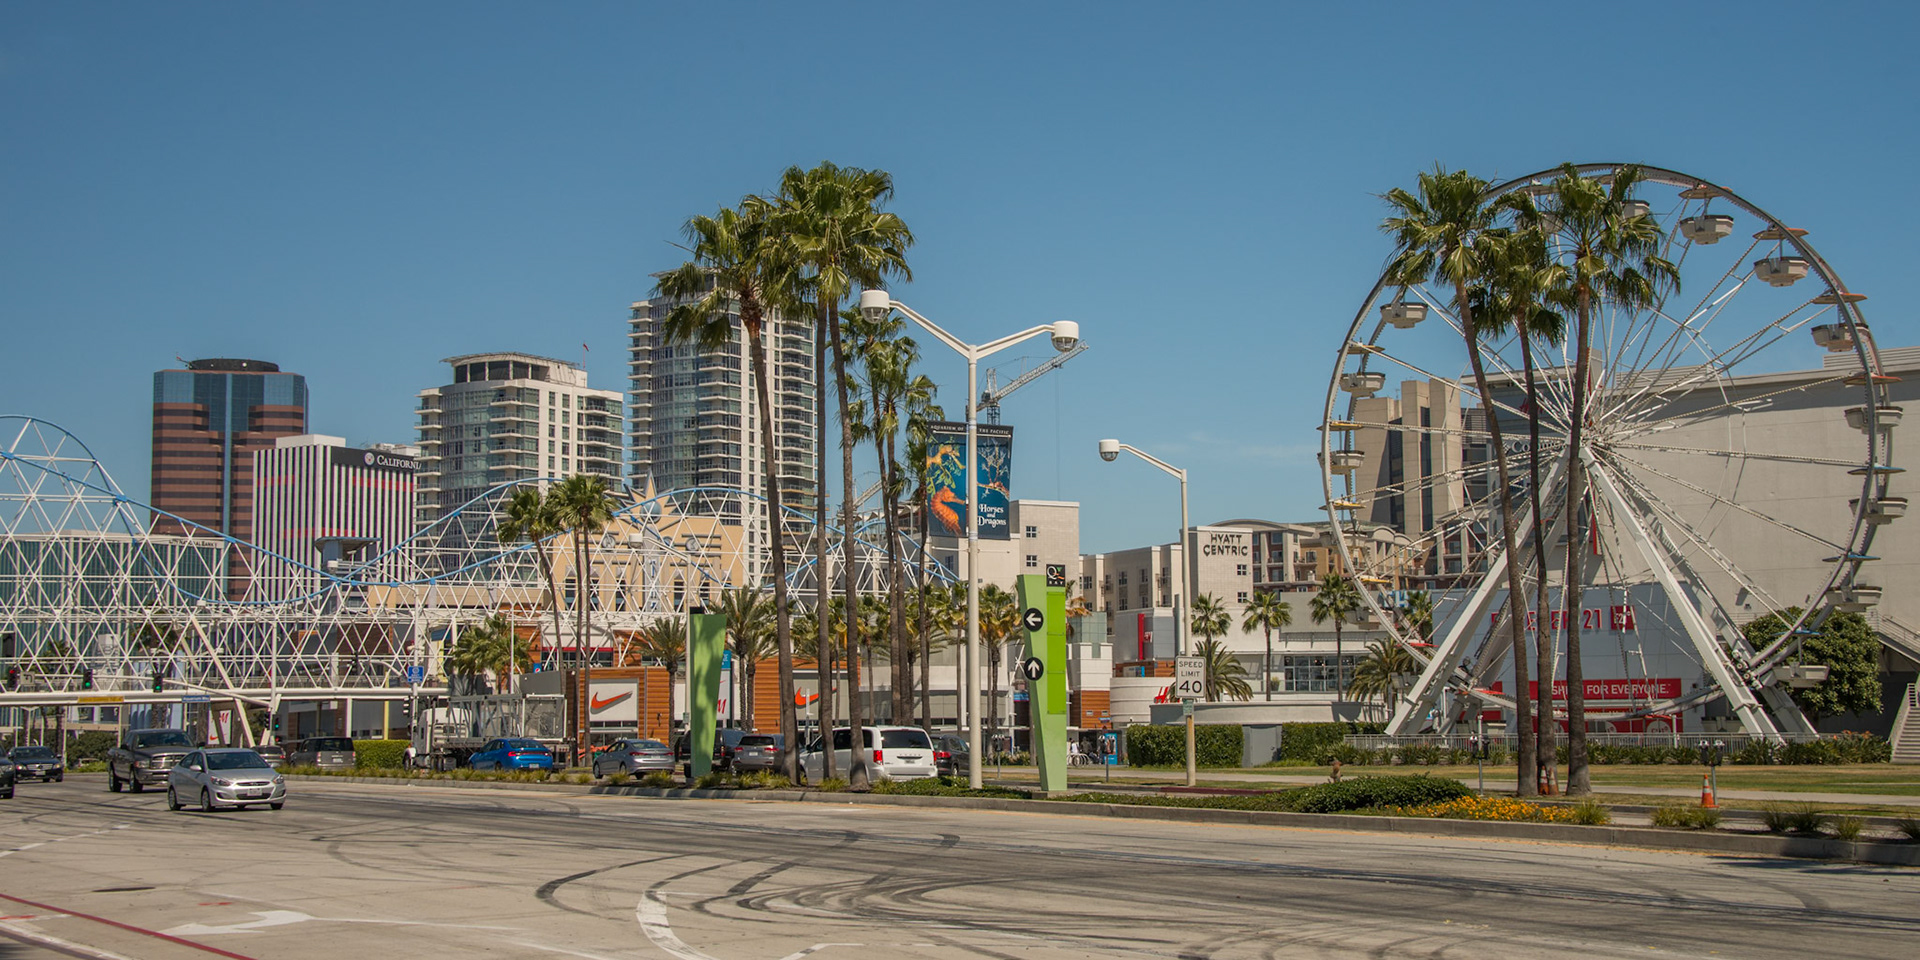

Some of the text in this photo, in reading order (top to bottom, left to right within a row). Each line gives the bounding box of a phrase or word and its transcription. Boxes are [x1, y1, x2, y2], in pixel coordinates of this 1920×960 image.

[978, 503, 1004, 513] Horses
[977, 515, 1007, 528] Dragons
[1210, 533, 1243, 545] HYATT
[1203, 544, 1249, 557] CENTRIC
[1583, 608, 1602, 630] 21
[1178, 660, 1204, 669] SPEED
[1178, 680, 1203, 694] 40
[1586, 684, 1609, 695] FOR
